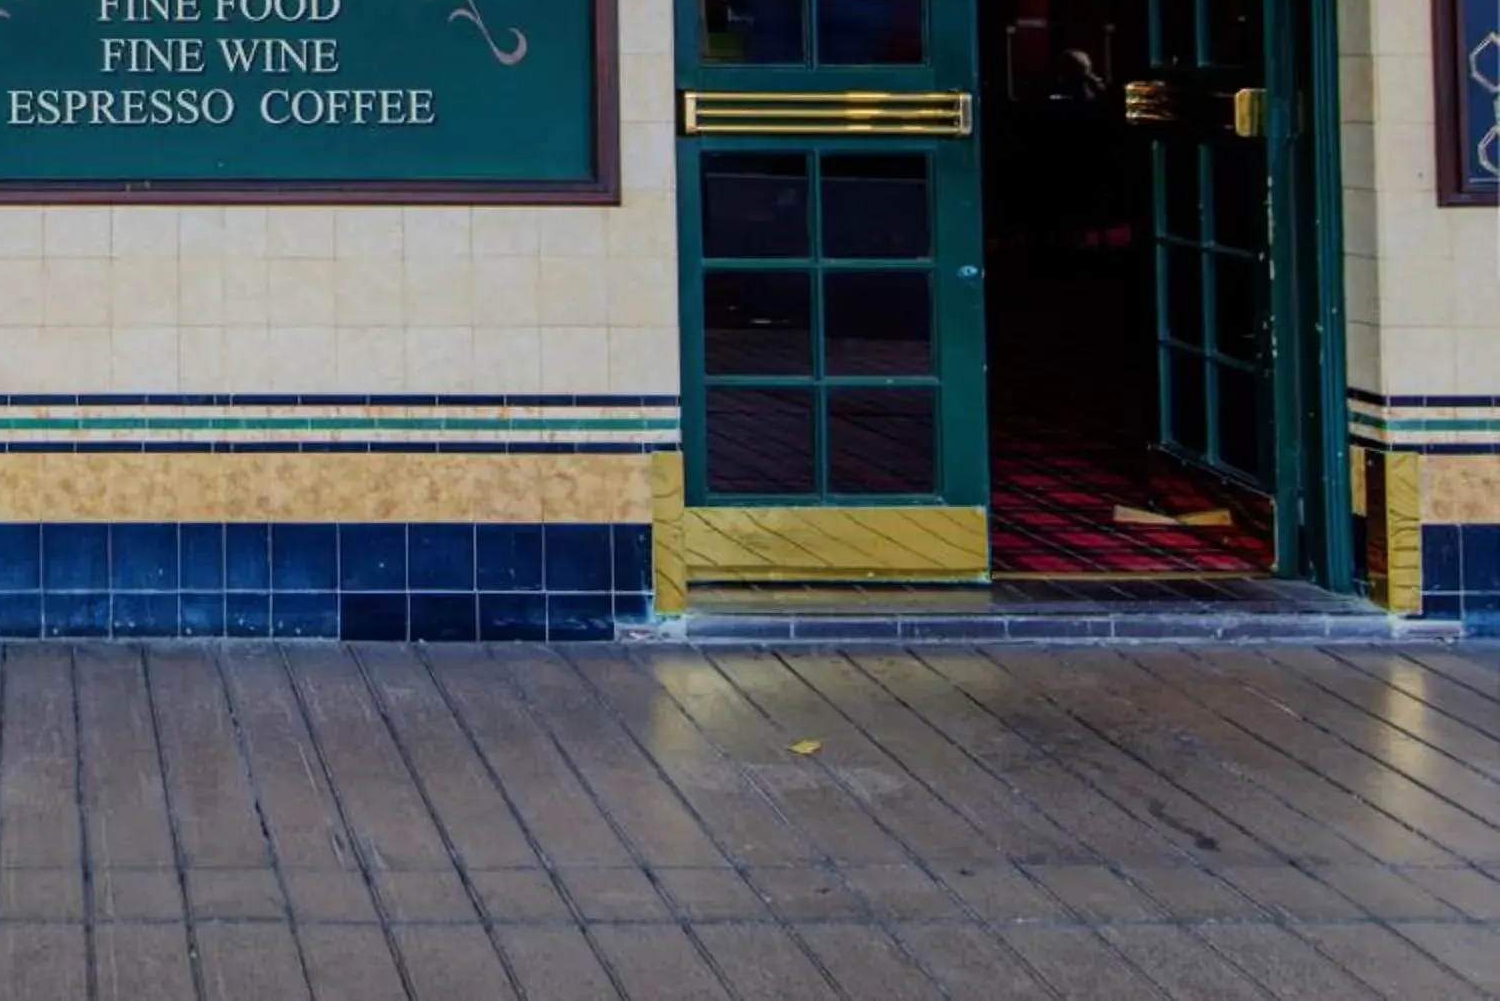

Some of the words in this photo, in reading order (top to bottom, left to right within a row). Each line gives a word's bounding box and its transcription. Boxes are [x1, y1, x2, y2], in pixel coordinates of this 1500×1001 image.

[99, 38, 206, 73] FINE
[217, 38, 340, 73] WINE
[7, 88, 235, 125] ESPRESSO
[260, 88, 437, 125] COFFEE
